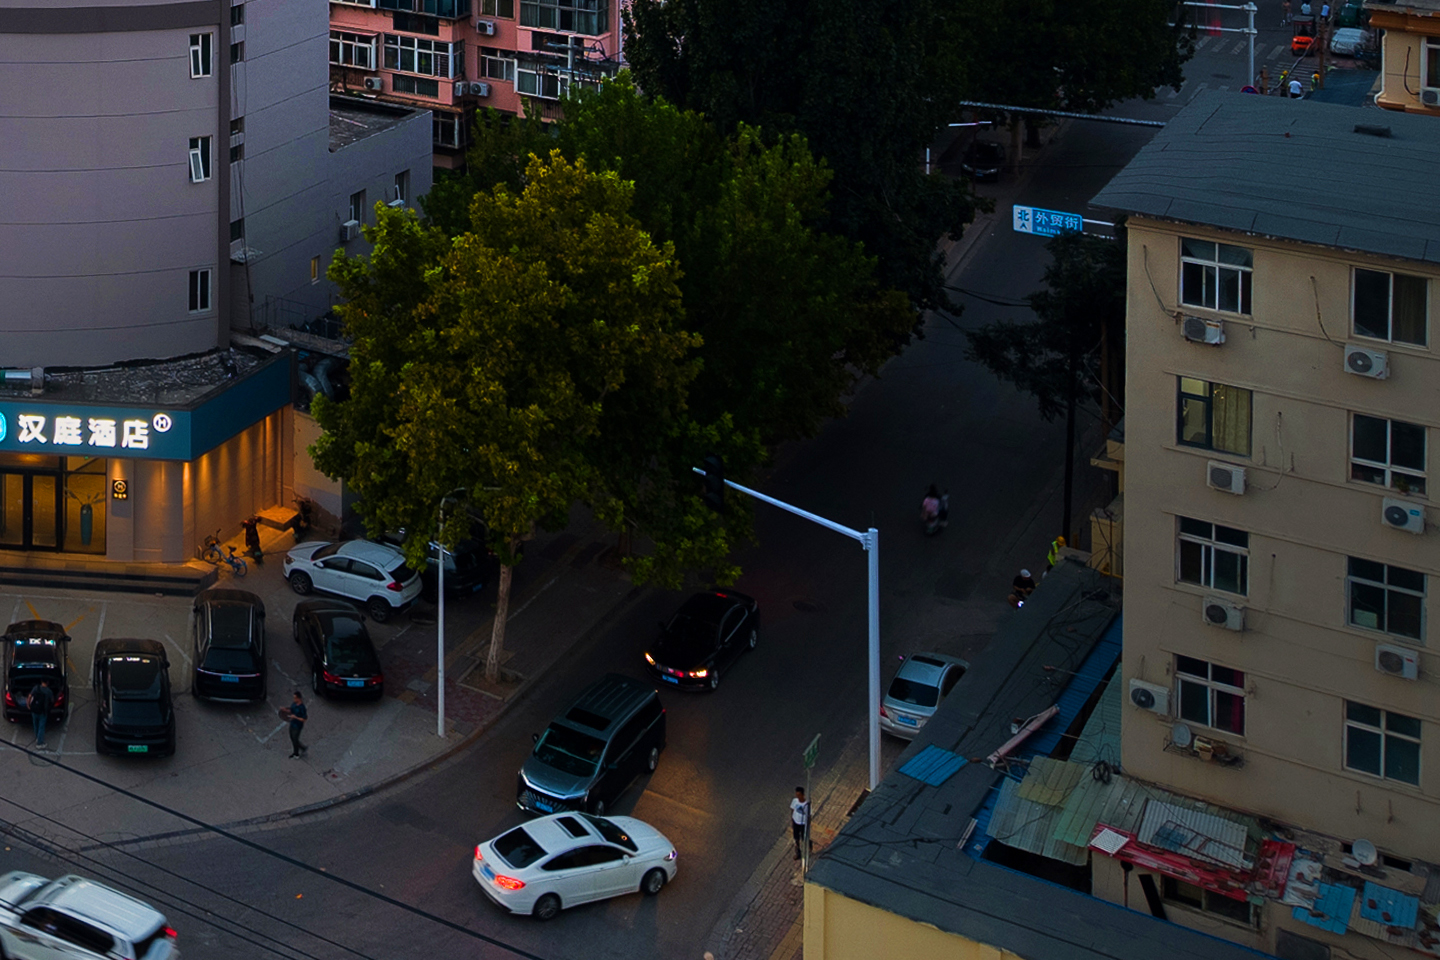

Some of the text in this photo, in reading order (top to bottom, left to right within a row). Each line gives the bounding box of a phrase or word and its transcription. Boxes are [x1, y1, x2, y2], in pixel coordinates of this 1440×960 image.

[1018, 210, 1029, 221] 北
[1035, 212, 1078, 230] 外贸街
[17, 414, 150, 450] 汉庭酒店
